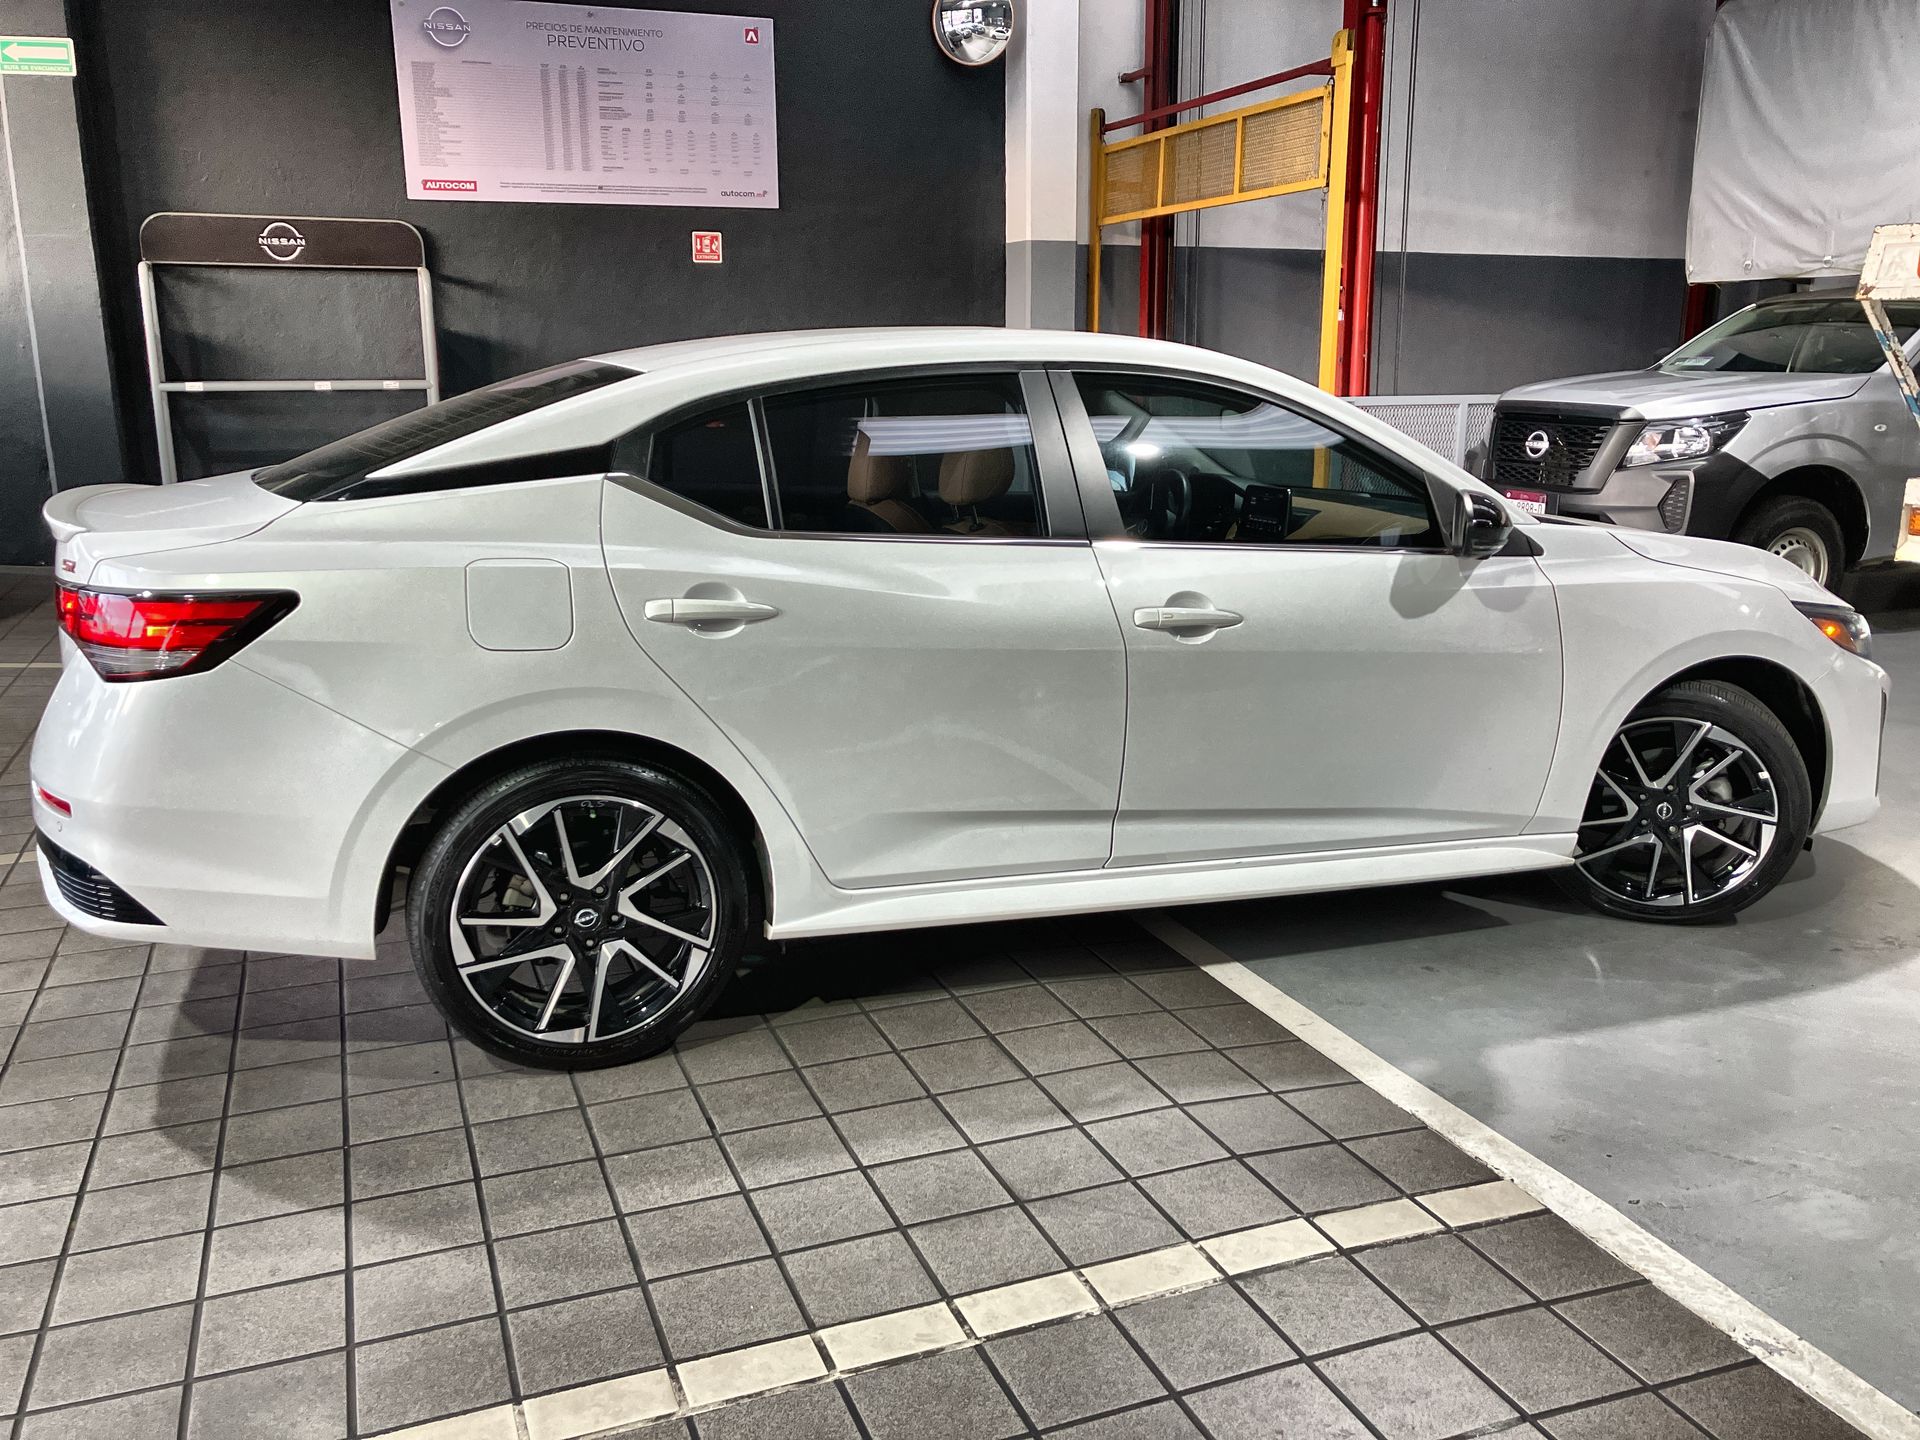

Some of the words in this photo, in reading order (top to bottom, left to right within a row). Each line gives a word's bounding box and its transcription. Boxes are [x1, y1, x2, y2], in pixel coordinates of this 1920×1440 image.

[423, 22, 471, 32] NISSAN
[525, 21, 567, 32] PRECIOS
[569, 24, 583, 33] DE
[585, 26, 663, 38] MANTENIMIENTO
[547, 34, 645, 52] PREVENTIVO
[425, 181, 475, 190] AUTOCOM
[258, 237, 306, 246] NISSAN
